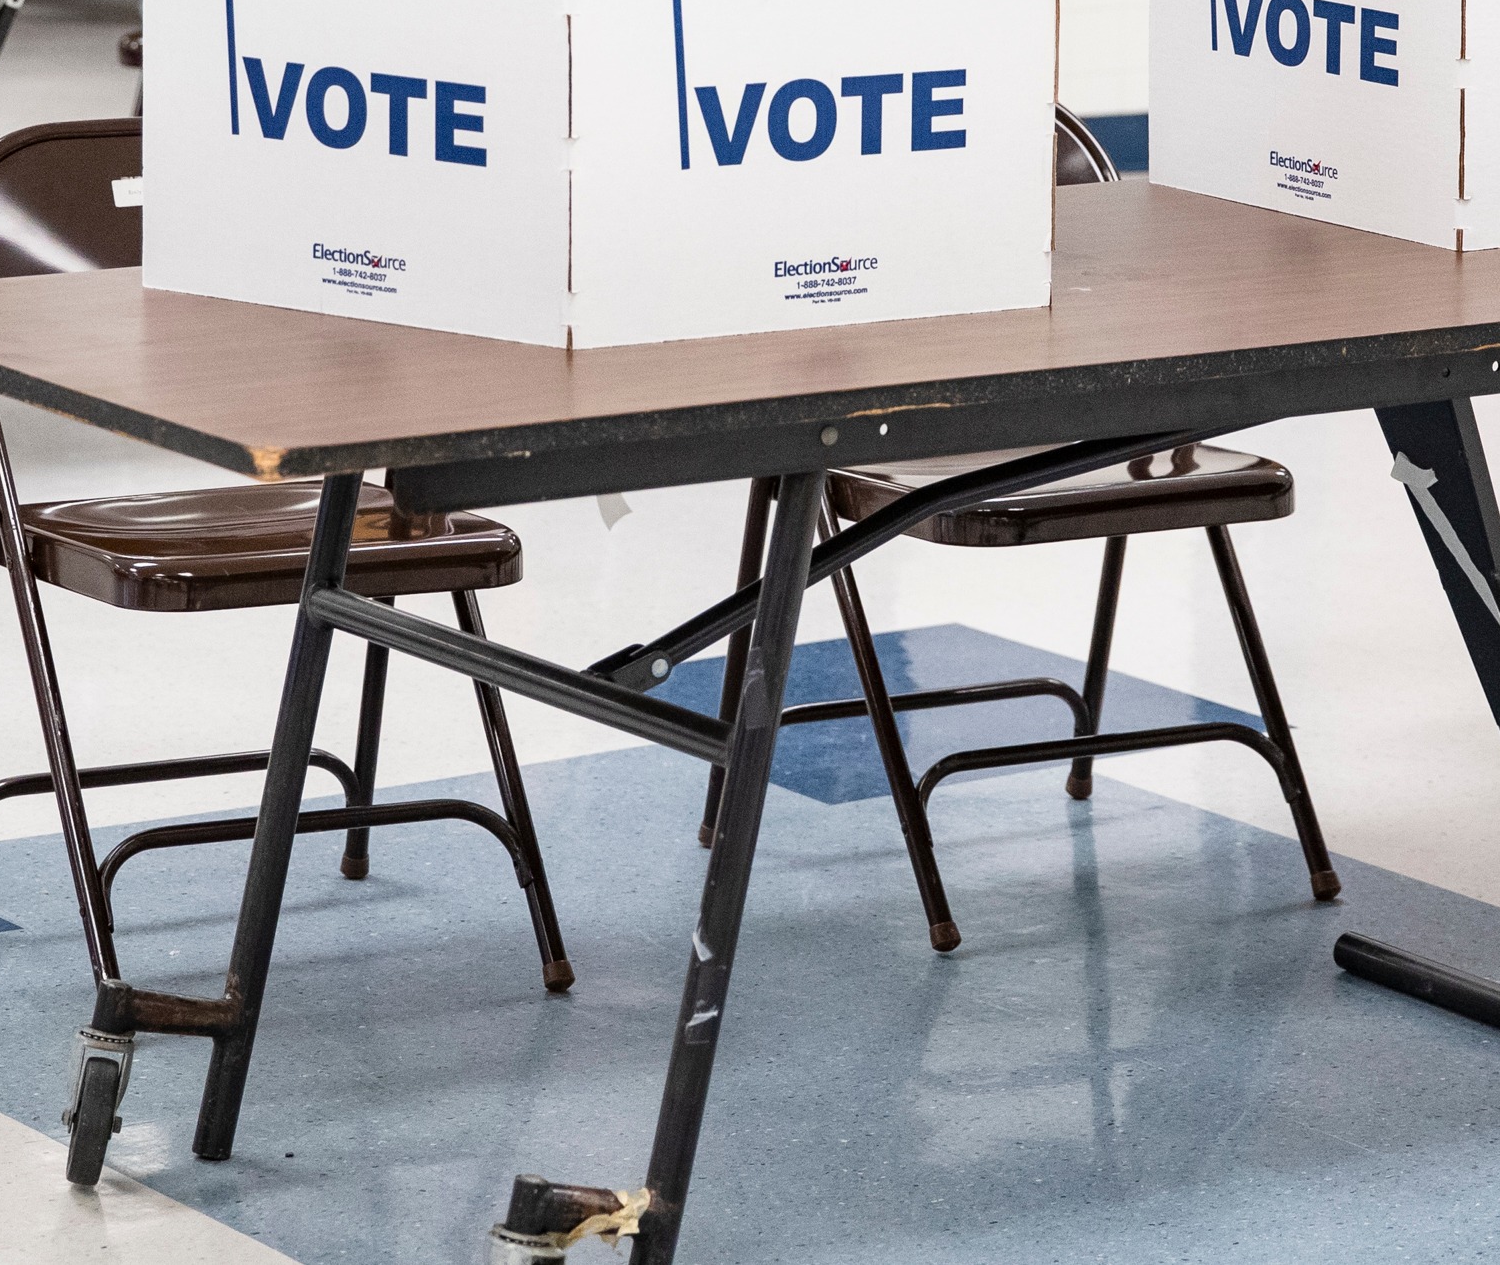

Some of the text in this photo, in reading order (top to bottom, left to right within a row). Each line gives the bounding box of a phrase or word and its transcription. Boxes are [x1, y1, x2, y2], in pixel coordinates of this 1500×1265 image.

[242, 56, 488, 167] VOTE
[693, 68, 968, 167] VOTE
[332, 267, 387, 282] 1-888-742-8037
[796, 276, 857, 289] 1-888-742-8037
[322, 277, 397, 294] www.electionsource.com
[784, 287, 868, 300] www.electionsource.com
